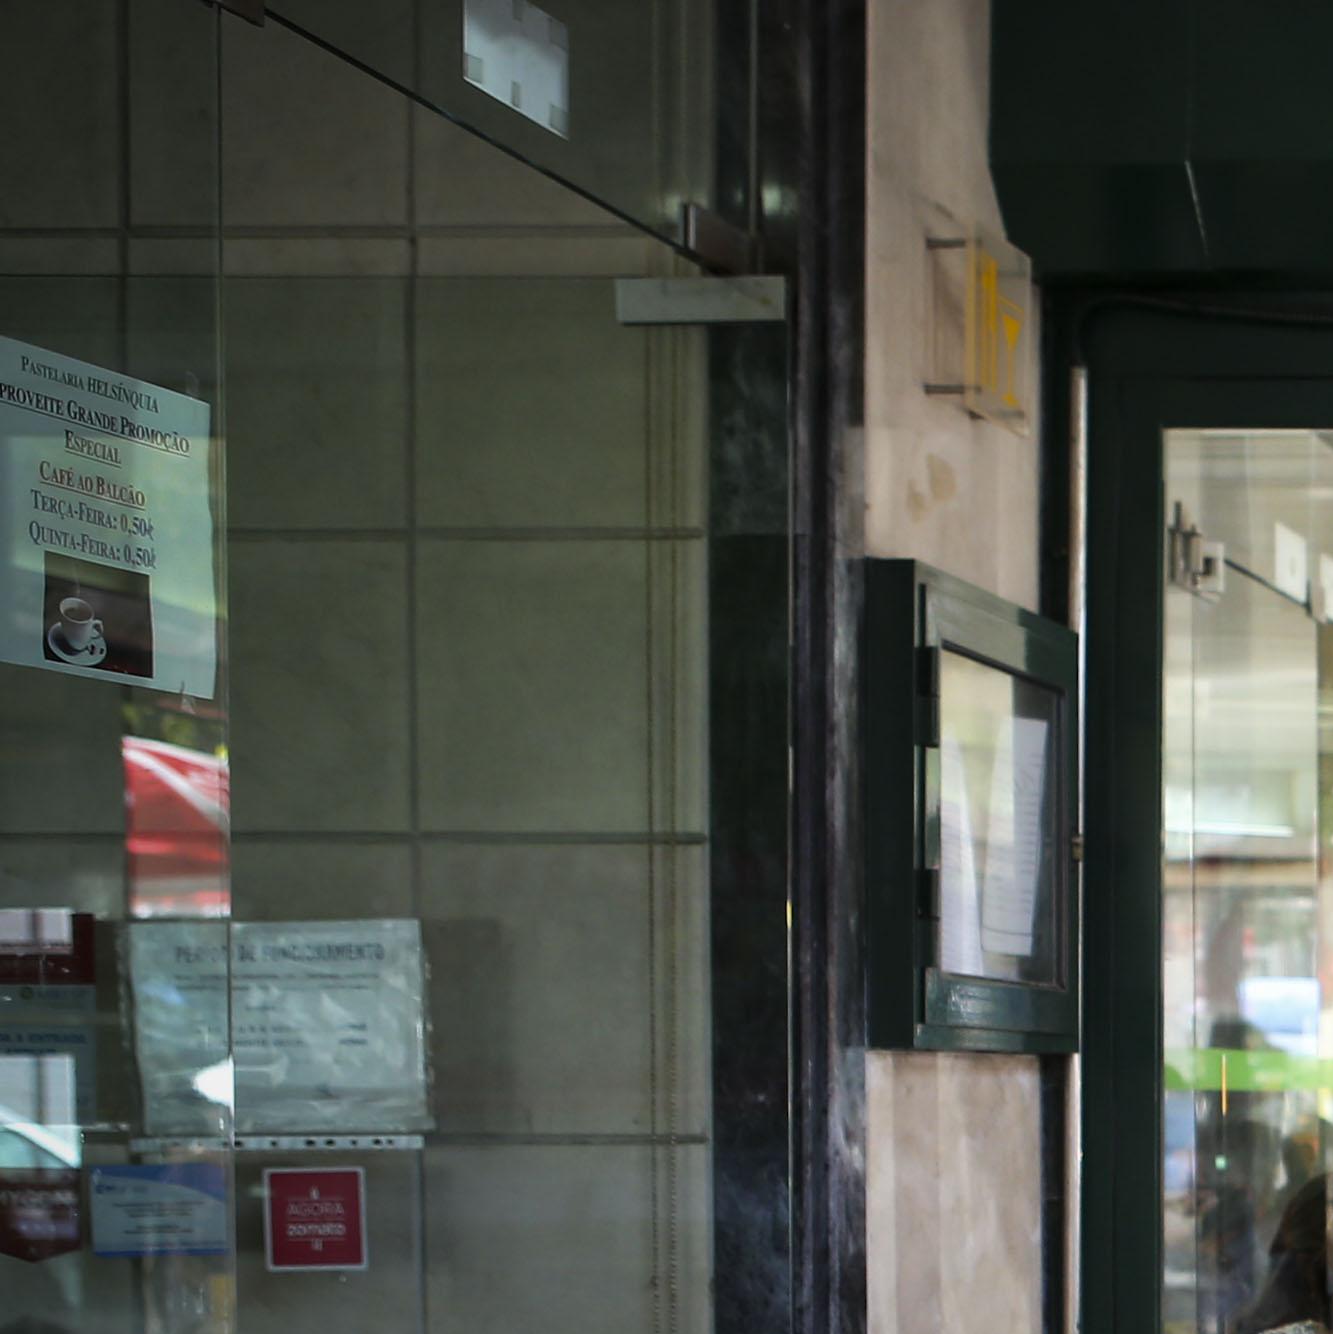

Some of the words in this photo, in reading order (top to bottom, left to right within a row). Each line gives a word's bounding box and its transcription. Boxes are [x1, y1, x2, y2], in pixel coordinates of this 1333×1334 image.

[21, 355, 85, 391] PASTELARIA
[87, 376, 160, 414] HELSÍNQUIA
[0, 383, 64, 415] PROVEITE
[67, 400, 117, 432] GRANDE
[120, 415, 191, 453] PROMOÇÃO
[64, 429, 122, 464] ESPECIAL
[40, 460, 74, 487] CAFÉ
[78, 476, 93, 492] AO
[95, 475, 146, 507] BALCÃO
[30, 489, 117, 530] TERÇA-FEIRA:
[29, 521, 120, 561] QUINTA-FEIRA:
